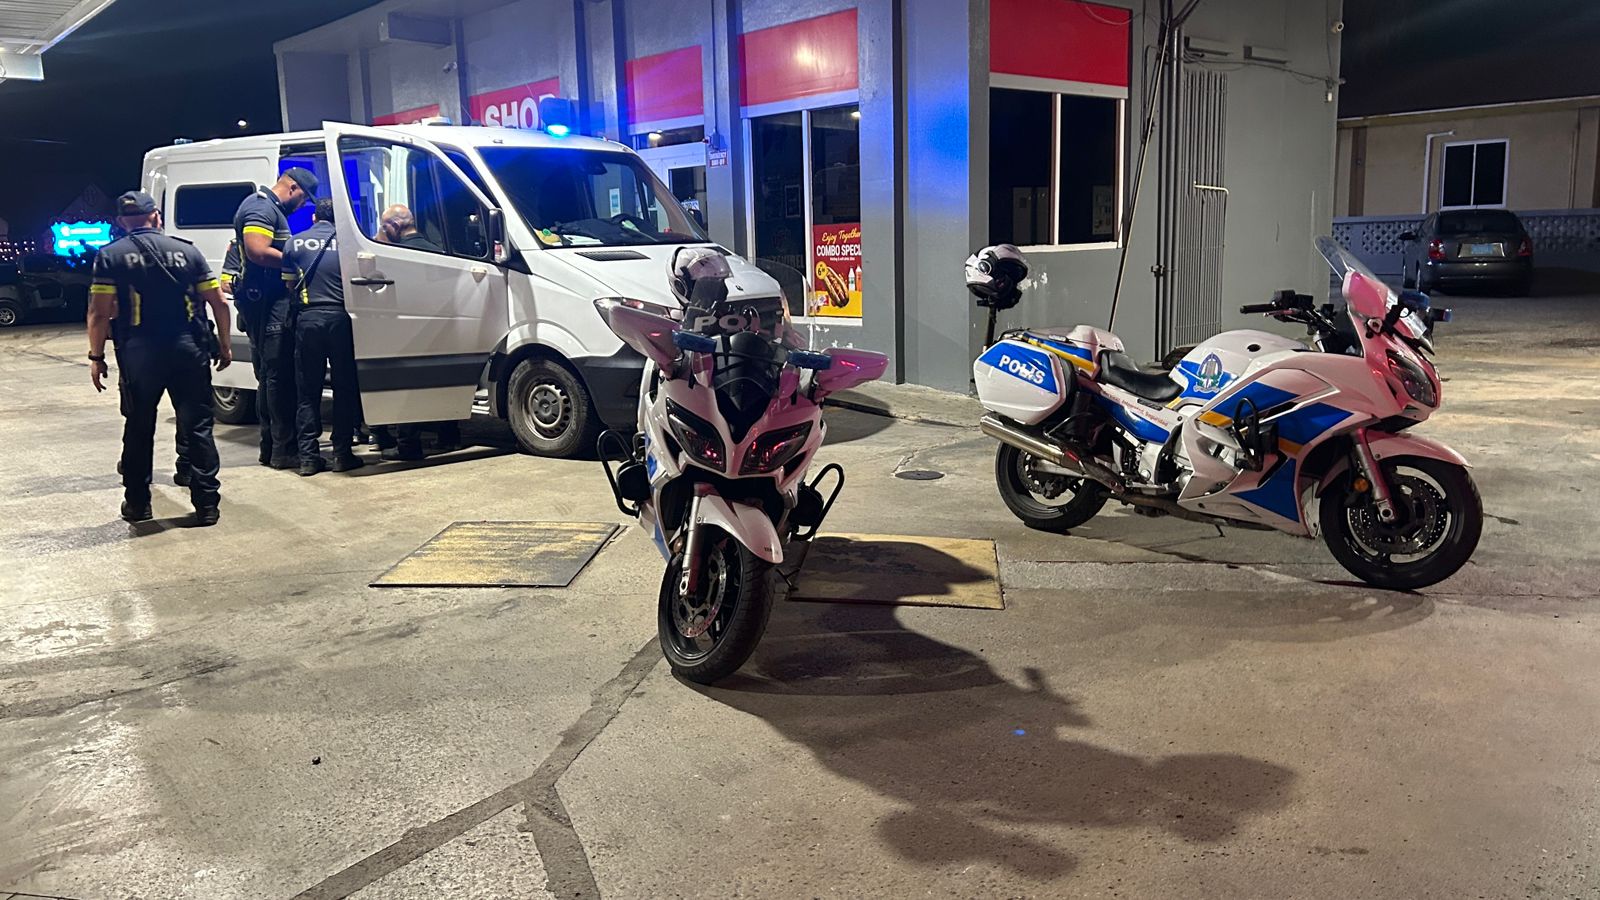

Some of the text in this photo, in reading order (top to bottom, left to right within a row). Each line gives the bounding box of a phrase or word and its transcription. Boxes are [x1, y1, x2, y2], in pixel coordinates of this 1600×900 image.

[822, 232, 837, 245] Enjoy
[816, 244, 862, 257] COMBO SPECI
[124, 251, 187, 268] PIS
[998, 354, 1046, 384] POLIS
